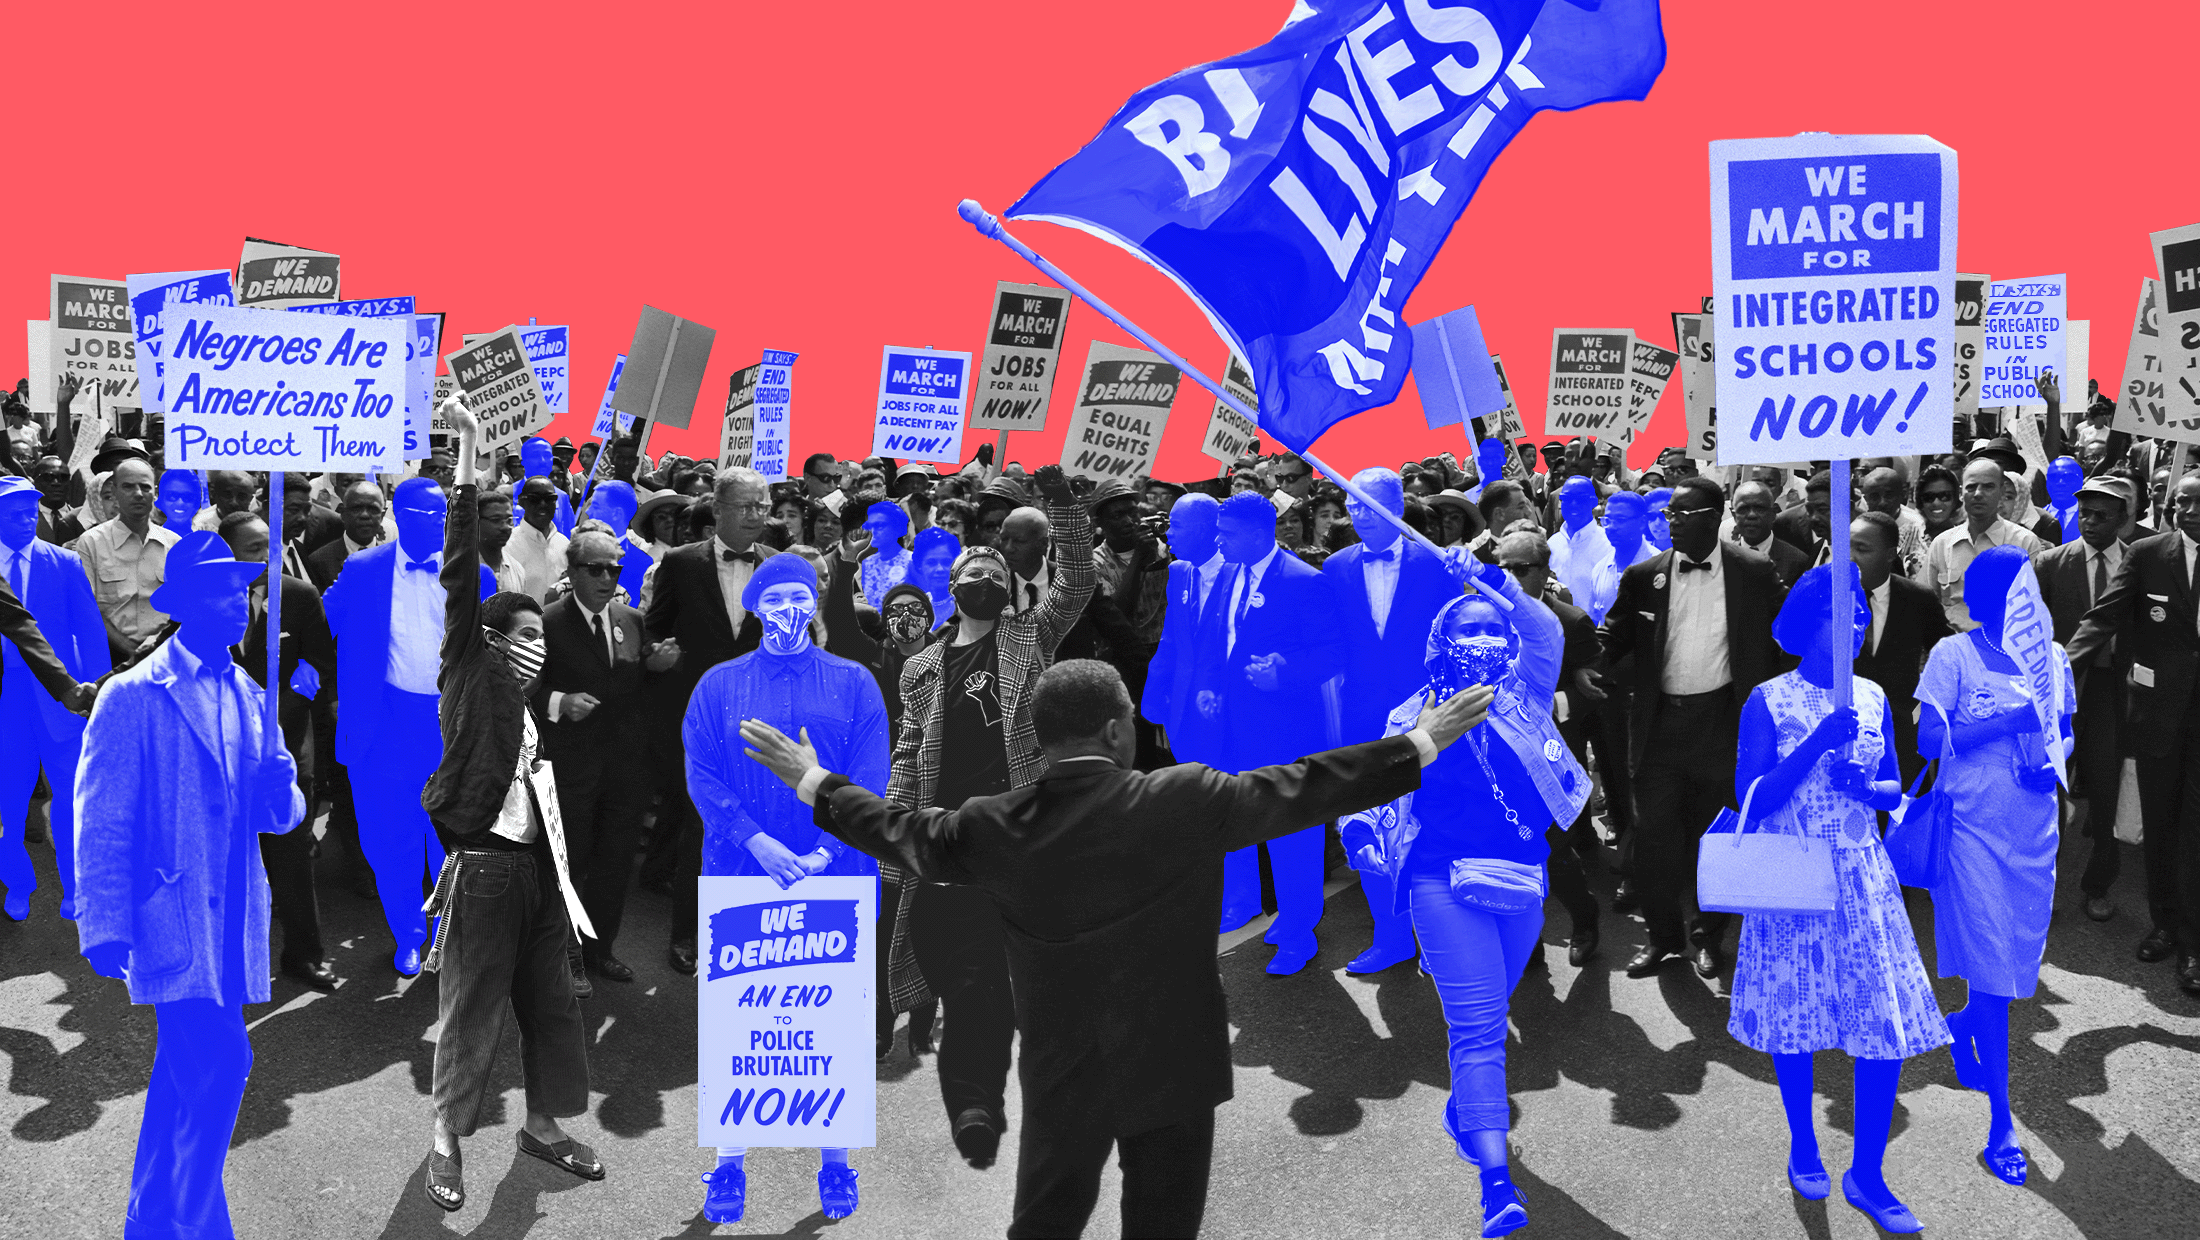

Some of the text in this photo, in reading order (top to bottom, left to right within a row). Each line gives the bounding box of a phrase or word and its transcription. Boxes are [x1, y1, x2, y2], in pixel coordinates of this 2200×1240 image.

[1269, 0, 1503, 282] LIVES
[1804, 165, 1867, 197] WE
[1746, 201, 1925, 246] MARCH
[272, 258, 309, 277] WE
[1803, 249, 1872, 270] FOR
[89, 288, 115, 302] WE
[164, 280, 200, 303] WE
[246, 275, 333, 299] DEMAND
[2010, 284, 2060, 297] SAYS:
[344, 298, 410, 317] SAYS:
[1023, 298, 1042, 314] WE
[1732, 285, 1940, 328] INTEGRATED
[1986, 301, 2045, 315] END
[87, 320, 117, 330] FOR
[998, 313, 1056, 335] MARCH
[1985, 317, 2060, 333] EGREGATED
[64, 337, 136, 360] JOBS
[172, 318, 323, 371] Negroes
[324, 327, 388, 369] Are
[524, 331, 548, 348] WE
[1014, 335, 1036, 345] FOR
[1582, 336, 1603, 348] WE
[1985, 334, 2048, 350] RULES
[472, 345, 494, 361] WE
[526, 340, 564, 359] MAND
[1561, 349, 1622, 363] MARCH
[1634, 345, 1660, 360] WE
[1733, 337, 1938, 379] SCHOOLS
[66, 360, 135, 373] FOR ALL
[460, 348, 517, 384] MARCH
[914, 358, 938, 371] WE
[990, 354, 1047, 378] JOBS
[1632, 358, 1671, 376] MAND
[2005, 355, 2027, 364] IN
[480, 369, 504, 384] FOR
[761, 368, 786, 385] END
[891, 369, 957, 388] MARCH
[1118, 363, 1156, 382] WE
[469, 372, 530, 408] NTEGRATED
[910, 386, 936, 396] FOR
[989, 380, 1040, 392] FOR ALL
[1088, 382, 1174, 402] DEMAND
[1554, 377, 1625, 390] INTEGRATED
[170, 372, 349, 419] Americans
[350, 378, 394, 418] Too
[1552, 394, 1623, 408] SCHOOLS
[759, 405, 784, 423] RULES
[881, 400, 960, 416] JOBS FOR ALL
[981, 397, 1042, 420] NOW!
[1749, 381, 1930, 442] NOW!
[485, 403, 538, 443] NOW!
[878, 415, 958, 431] A DECENT PAY
[1089, 408, 1151, 437] EQUAL
[1555, 410, 1619, 429] NOW!
[170, 422, 302, 462] Protect
[313, 423, 386, 463] Them
[765, 428, 776, 438] IN
[1082, 427, 1150, 457] RIGHTS
[756, 438, 784, 457] PUBLIC
[884, 433, 953, 454] NOW!
[1073, 449, 1147, 480] NOW!
[760, 902, 807, 934] WE
[718, 930, 848, 972] DEMAND
[738, 984, 833, 1008] AN END
[773, 1015, 793, 1026] TO
[750, 1030, 814, 1051] POLICE
[732, 1055, 833, 1077] BRUTALITY
[719, 1087, 846, 1128] NOW!
